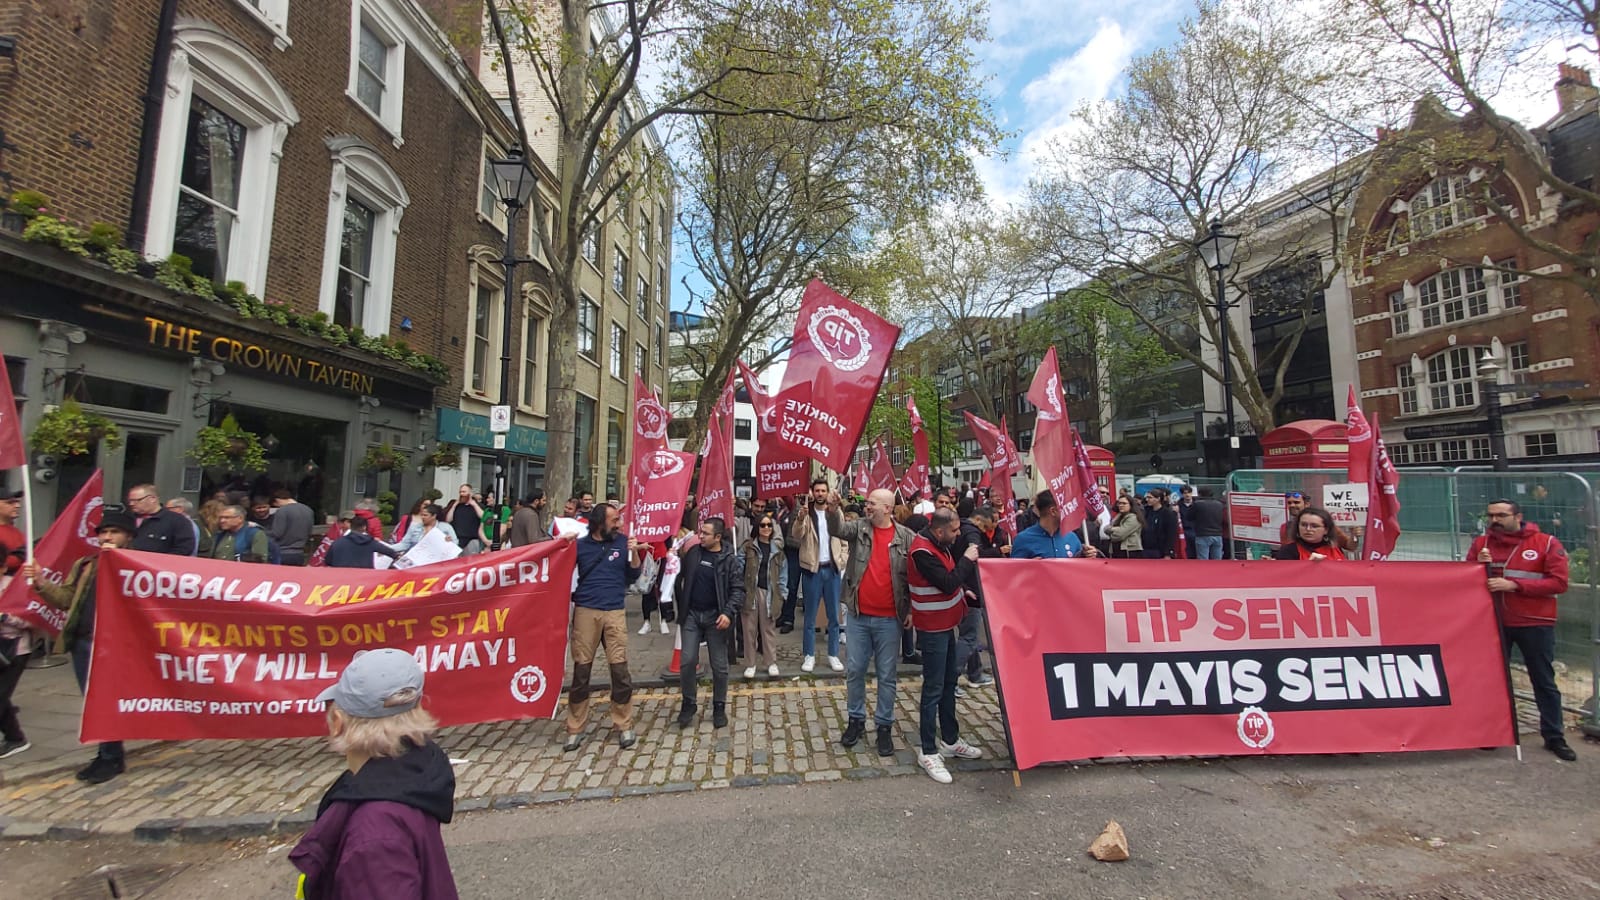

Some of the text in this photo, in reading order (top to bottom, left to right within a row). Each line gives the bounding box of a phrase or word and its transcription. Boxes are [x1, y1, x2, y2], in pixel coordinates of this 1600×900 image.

[145, 316, 375, 394] THE CROWN TAVERN
[1331, 490, 1352, 501] WE
[119, 557, 550, 606] ZORBALAR KALMAZ GİDER!
[153, 607, 510, 648] TYRANTS DON'T STAY
[154, 652, 246, 684] THEY
[254, 651, 338, 682] WILL
[414, 637, 517, 673] AWAY!
[520, 673, 538, 687] TİP
[1053, 663, 1079, 709] 1
[1093, 659, 1268, 707] MAYIS
[118, 698, 206, 714] WORKERS'
[209, 701, 263, 715] PARTY
[267, 701, 293, 714] OF
[1246, 715, 1265, 729] TİP
